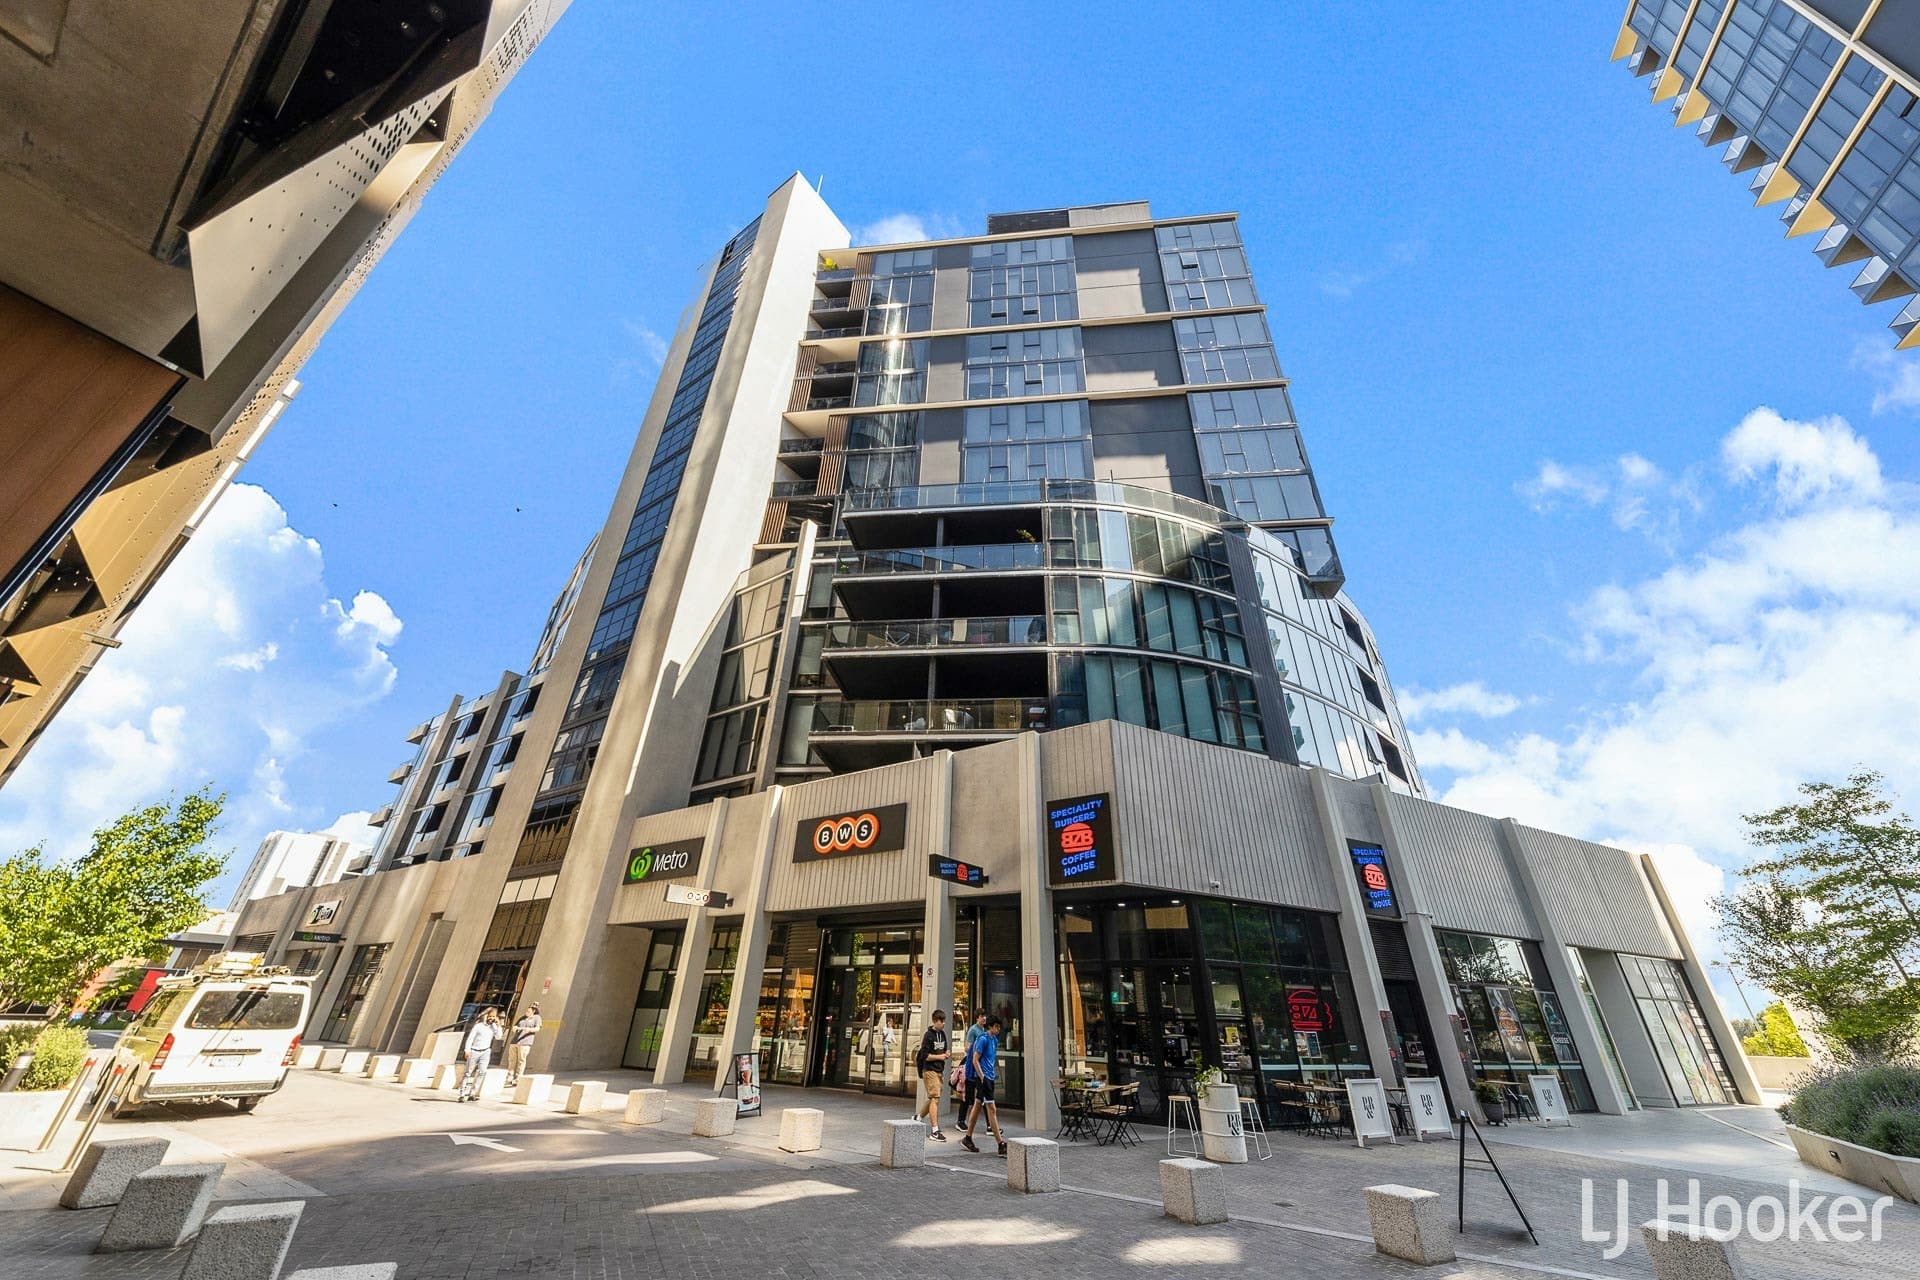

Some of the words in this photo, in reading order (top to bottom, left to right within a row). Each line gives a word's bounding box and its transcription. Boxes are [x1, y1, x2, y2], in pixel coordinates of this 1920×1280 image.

[1051, 800, 1102, 819] SPECIALITY
[1055, 811, 1096, 828] BURGERS
[652, 850, 688, 873] Metro
[1061, 849, 1096, 866] COFFEE
[1063, 861, 1096, 877] HOUSE
